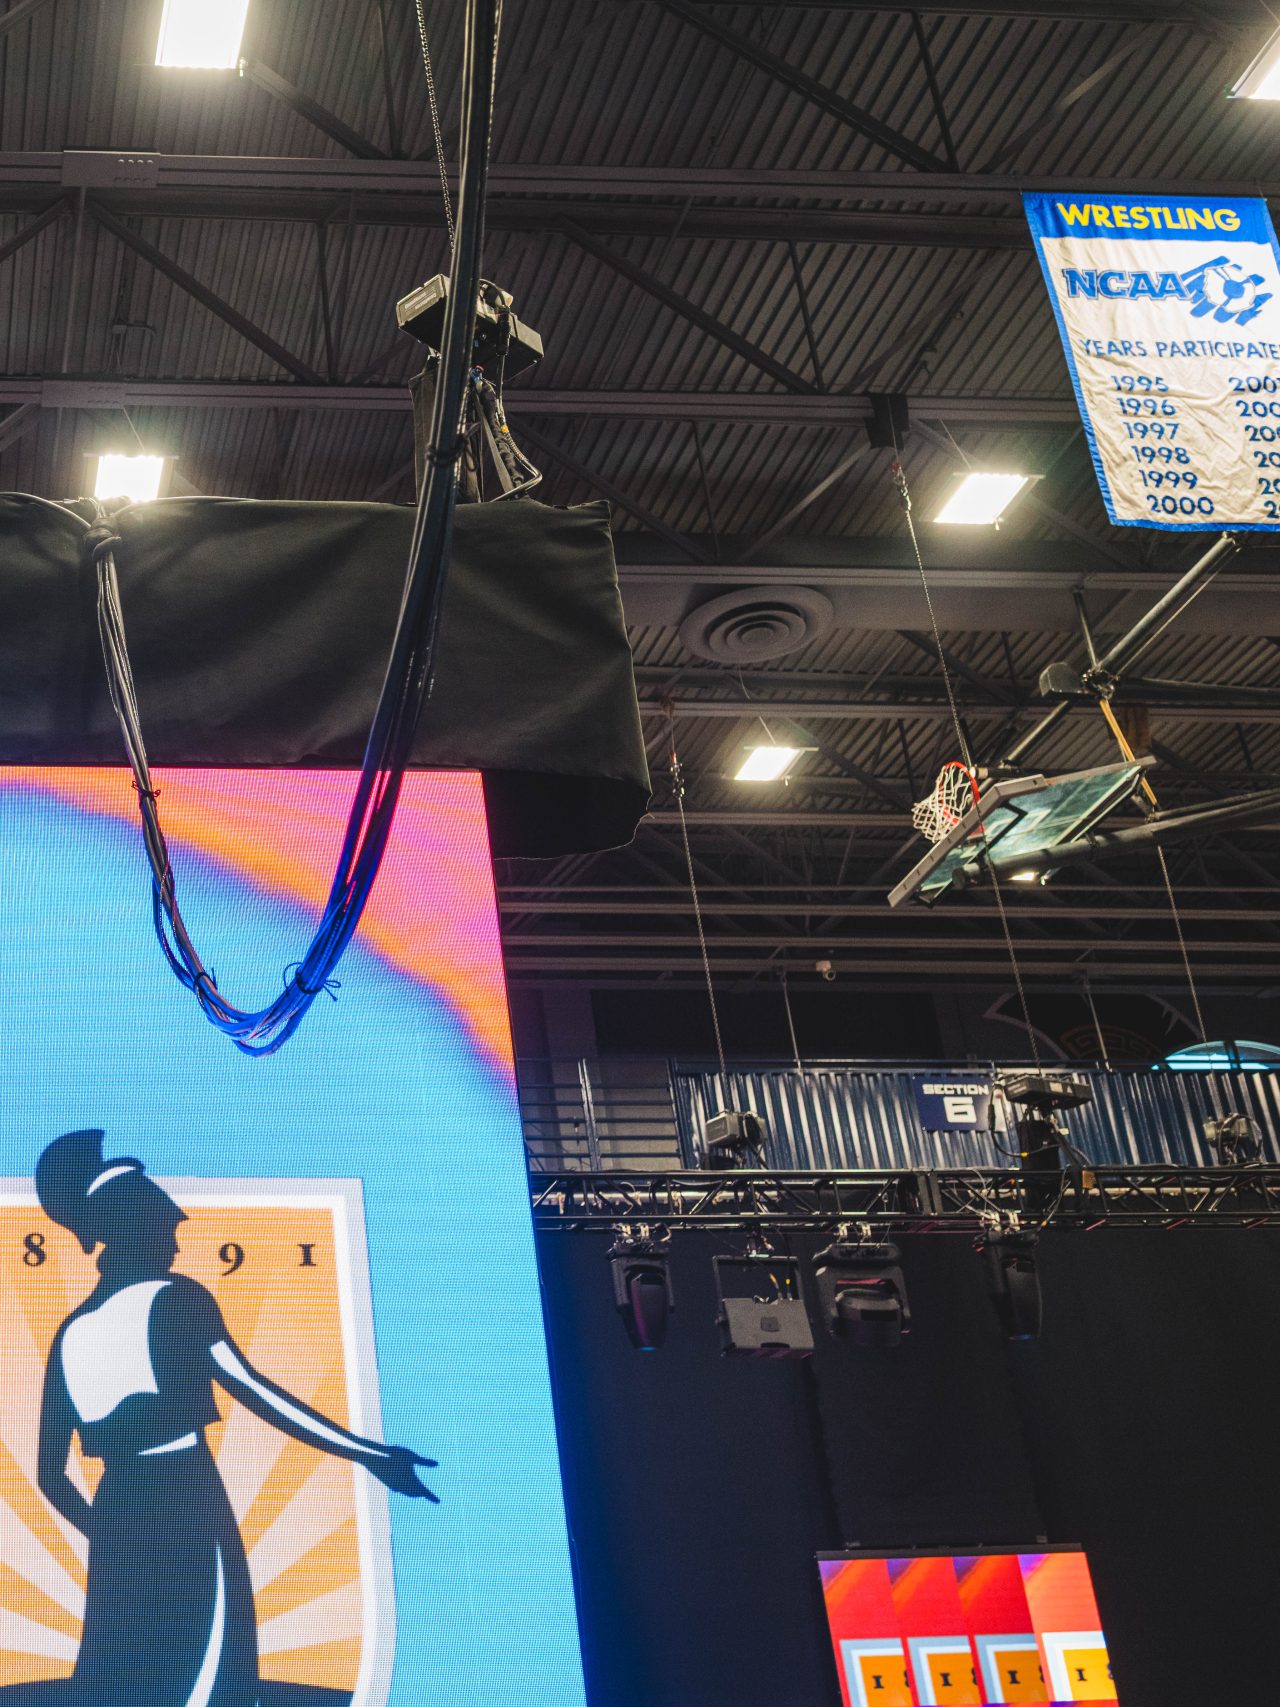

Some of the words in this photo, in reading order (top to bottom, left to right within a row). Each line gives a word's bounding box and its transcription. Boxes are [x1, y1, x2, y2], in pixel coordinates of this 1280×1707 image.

[1057, 203, 1241, 231] WRESTLING
[1062, 268, 1192, 300] NCAA
[1080, 339, 1148, 357] YEARS
[1155, 340, 1280, 360] PARTICIPATE
[1111, 375, 1169, 393] 1995
[1116, 398, 1177, 416] 1996
[1122, 422, 1180, 440] 1997
[1244, 424, 1280, 442] 20
[1130, 445, 1191, 465] 1998
[1138, 469, 1198, 491] 1999
[1146, 494, 1215, 516] 2000
[922, 1083, 989, 1095] SECTION
[943, 1096, 977, 1123] 6
